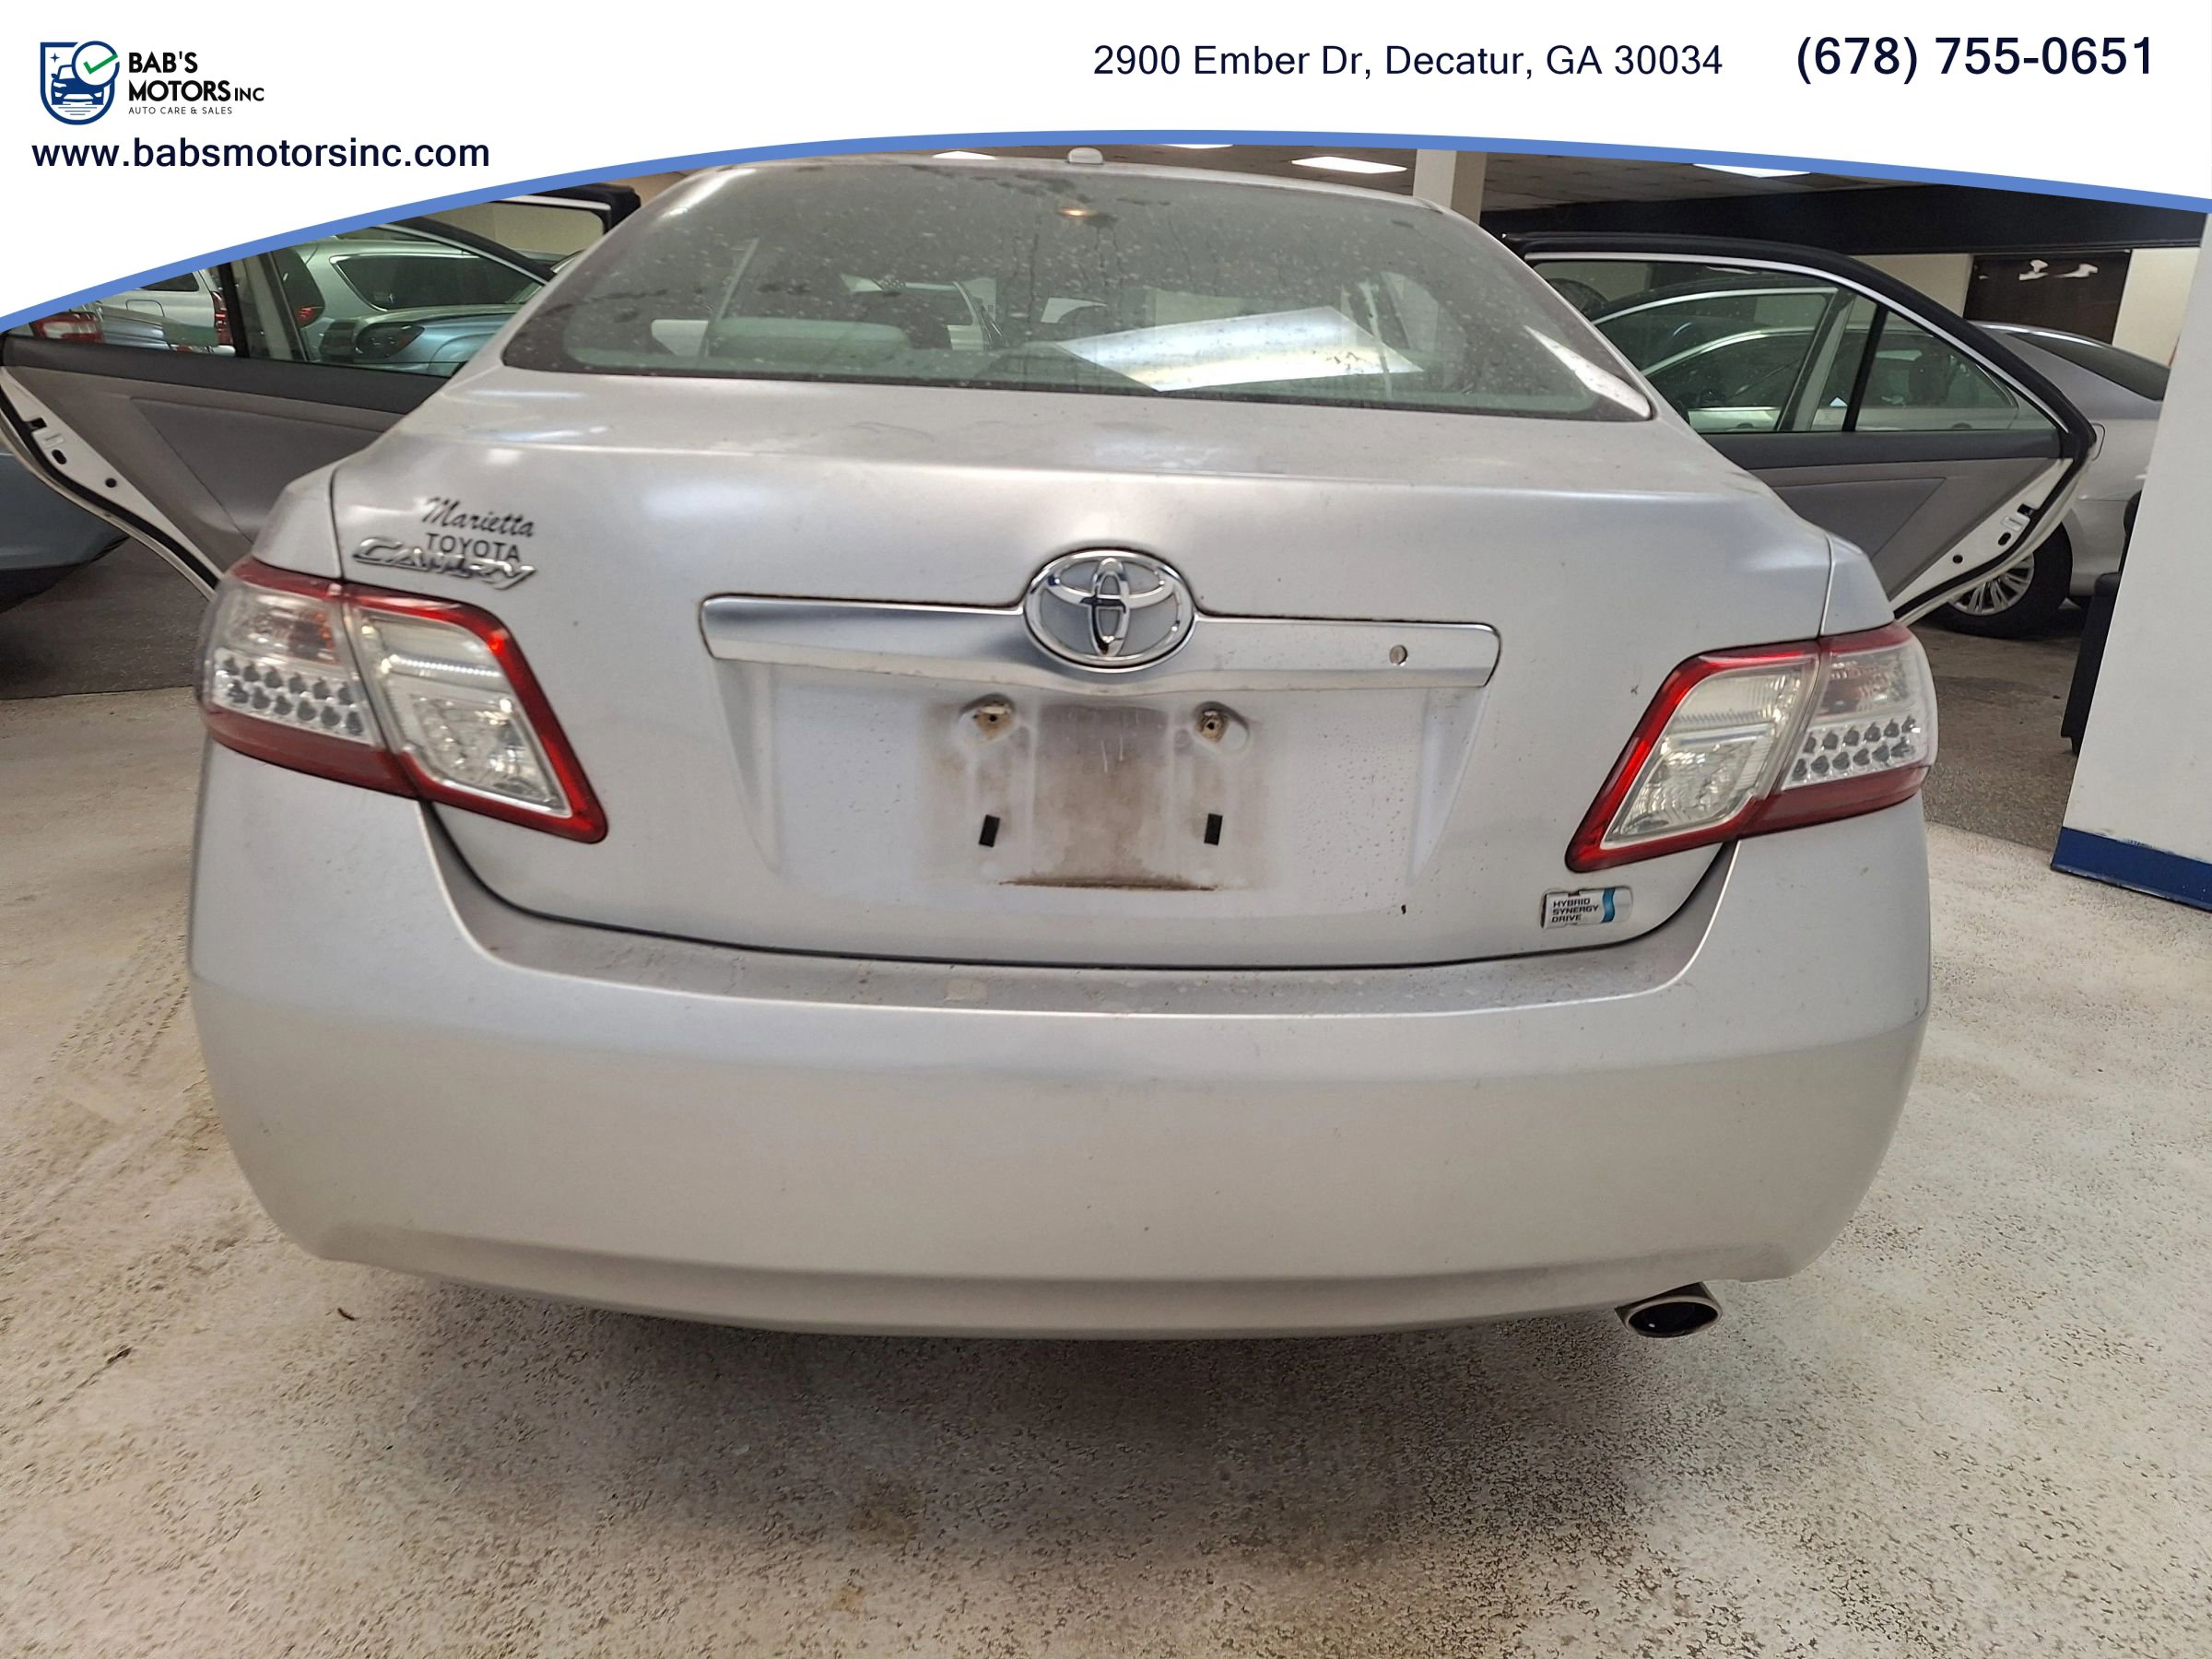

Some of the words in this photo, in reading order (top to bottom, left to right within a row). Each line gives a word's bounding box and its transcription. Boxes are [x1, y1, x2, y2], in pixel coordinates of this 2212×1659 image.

[421, 497, 535, 537] Marietta
[425, 532, 521, 562] TOYOTA
[1553, 898, 1591, 908] HYBRID
[1552, 904, 1599, 916] SYNERGY
[1551, 913, 1582, 923] DRIVE
